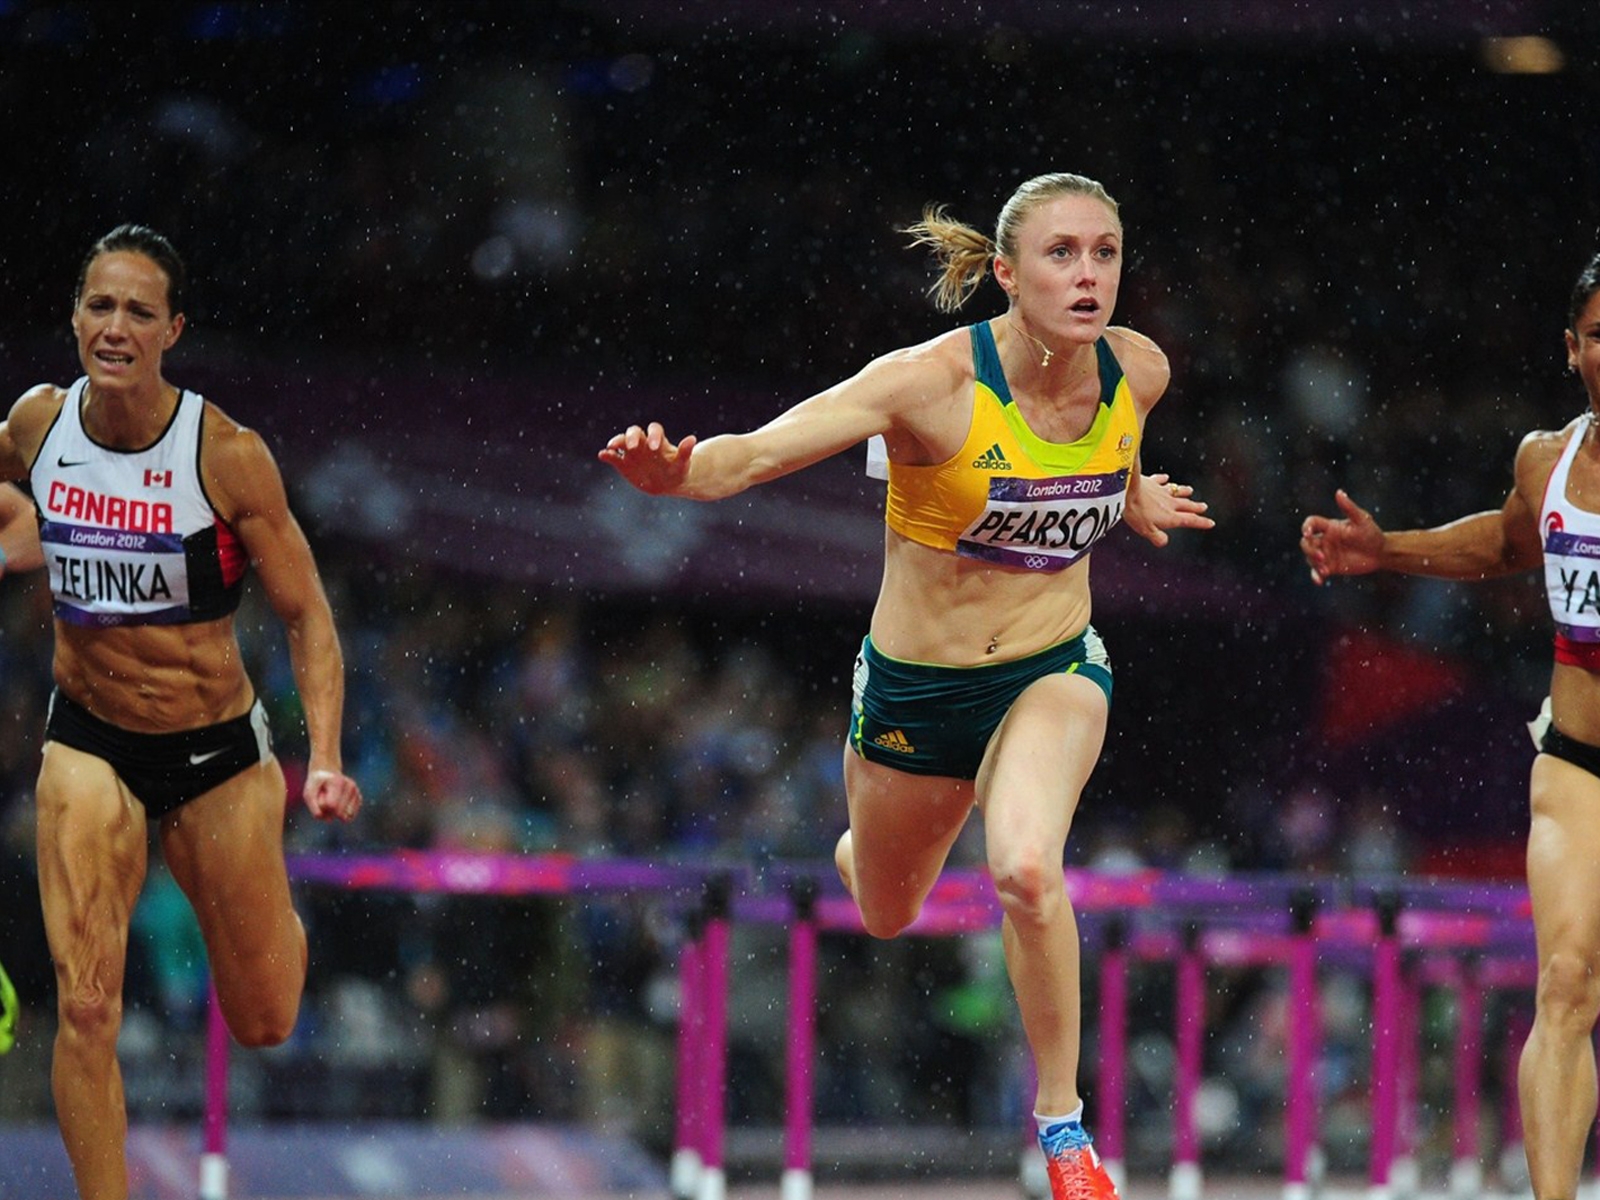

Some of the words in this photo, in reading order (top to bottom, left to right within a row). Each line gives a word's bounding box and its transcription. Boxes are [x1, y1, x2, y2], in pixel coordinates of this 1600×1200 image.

[972, 459, 1012, 471] adidas
[1026, 481, 1071, 497] London
[1073, 479, 1102, 494] 2012
[48, 481, 173, 534] CANADA
[70, 528, 115, 547] London
[116, 533, 147, 550] 2012
[970, 502, 1121, 551] PEARSON
[55, 555, 172, 604] ZELINKA
[1560, 567, 1600, 616] YA
[874, 737, 915, 754] adidas
